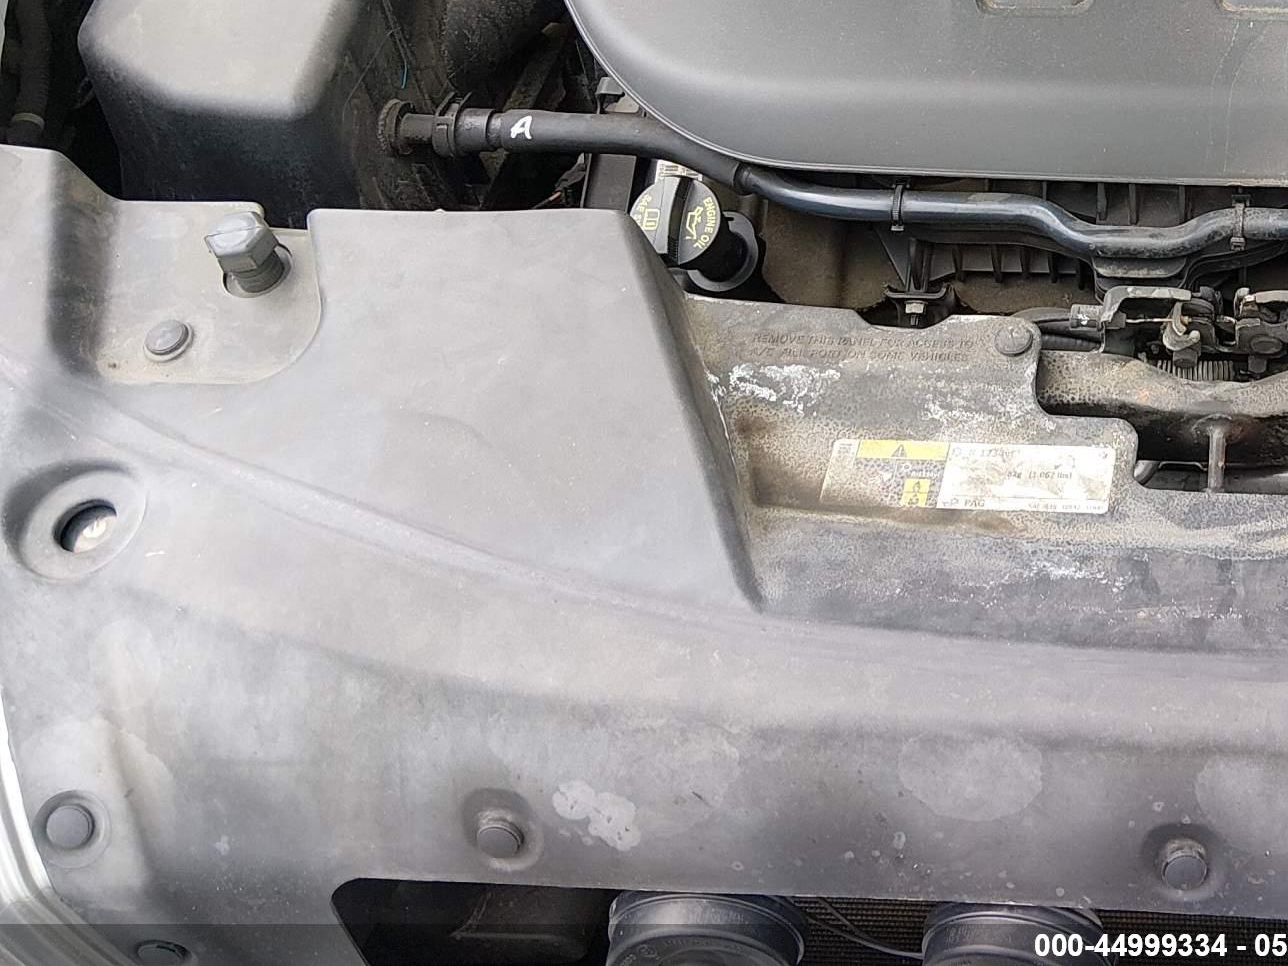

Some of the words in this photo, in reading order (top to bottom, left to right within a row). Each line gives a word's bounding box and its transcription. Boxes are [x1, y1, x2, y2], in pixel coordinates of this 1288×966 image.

[510, 115, 533, 140] A
[703, 196, 718, 234] ENGINE
[693, 234, 710, 249] OIL
[753, 333, 806, 345] REMOVE
[963, 498, 986, 508] PAG
